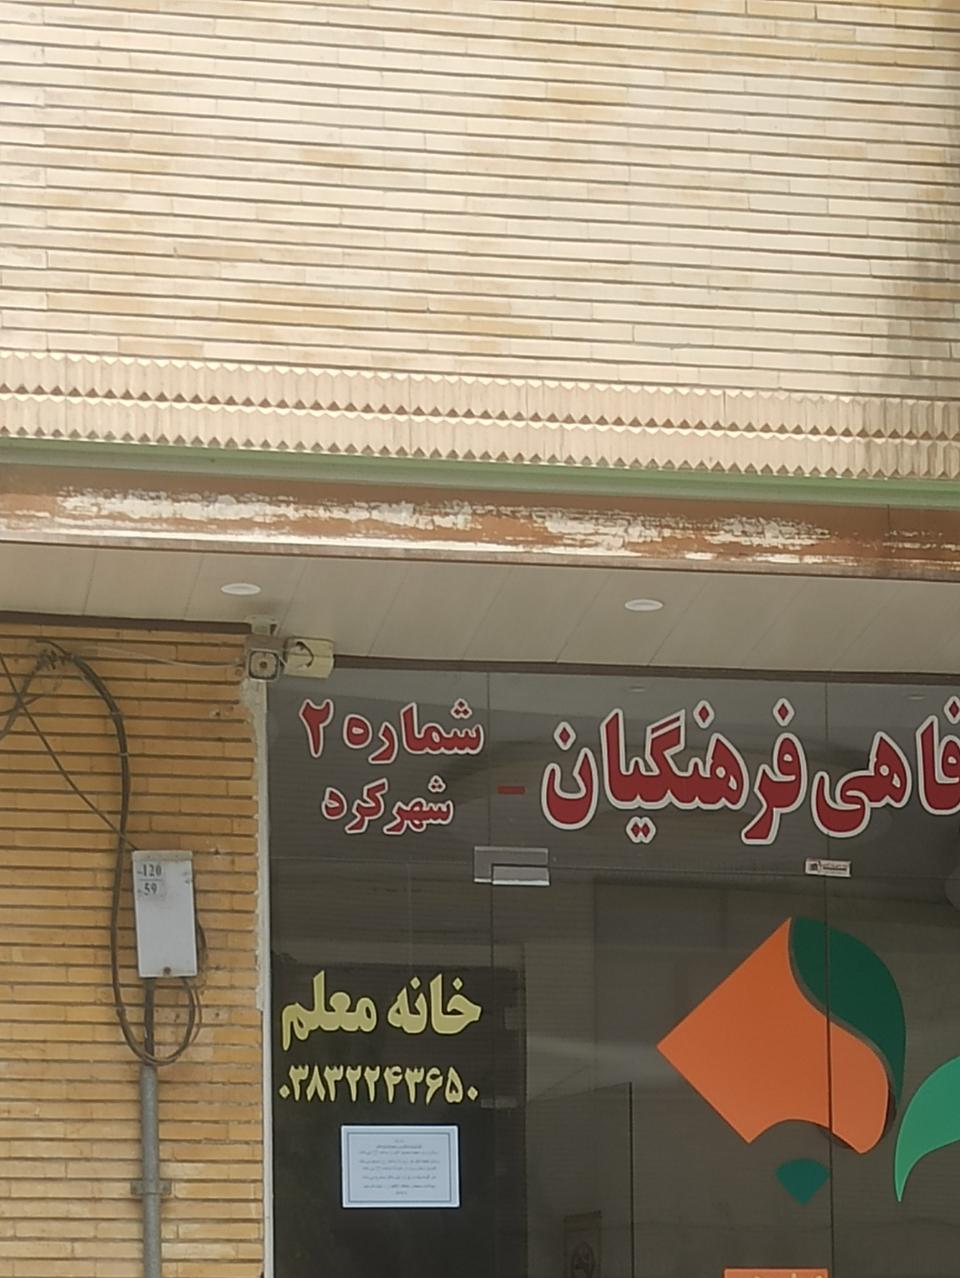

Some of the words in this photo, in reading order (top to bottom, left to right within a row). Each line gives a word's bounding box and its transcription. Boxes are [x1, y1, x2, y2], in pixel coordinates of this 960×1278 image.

[299, 698, 334, 758] ۲
[342, 698, 484, 764] شماره
[540, 698, 808, 845] فرهنگیان
[281, 969, 378, 1051] معلم
[387, 974, 482, 1035] خانه
